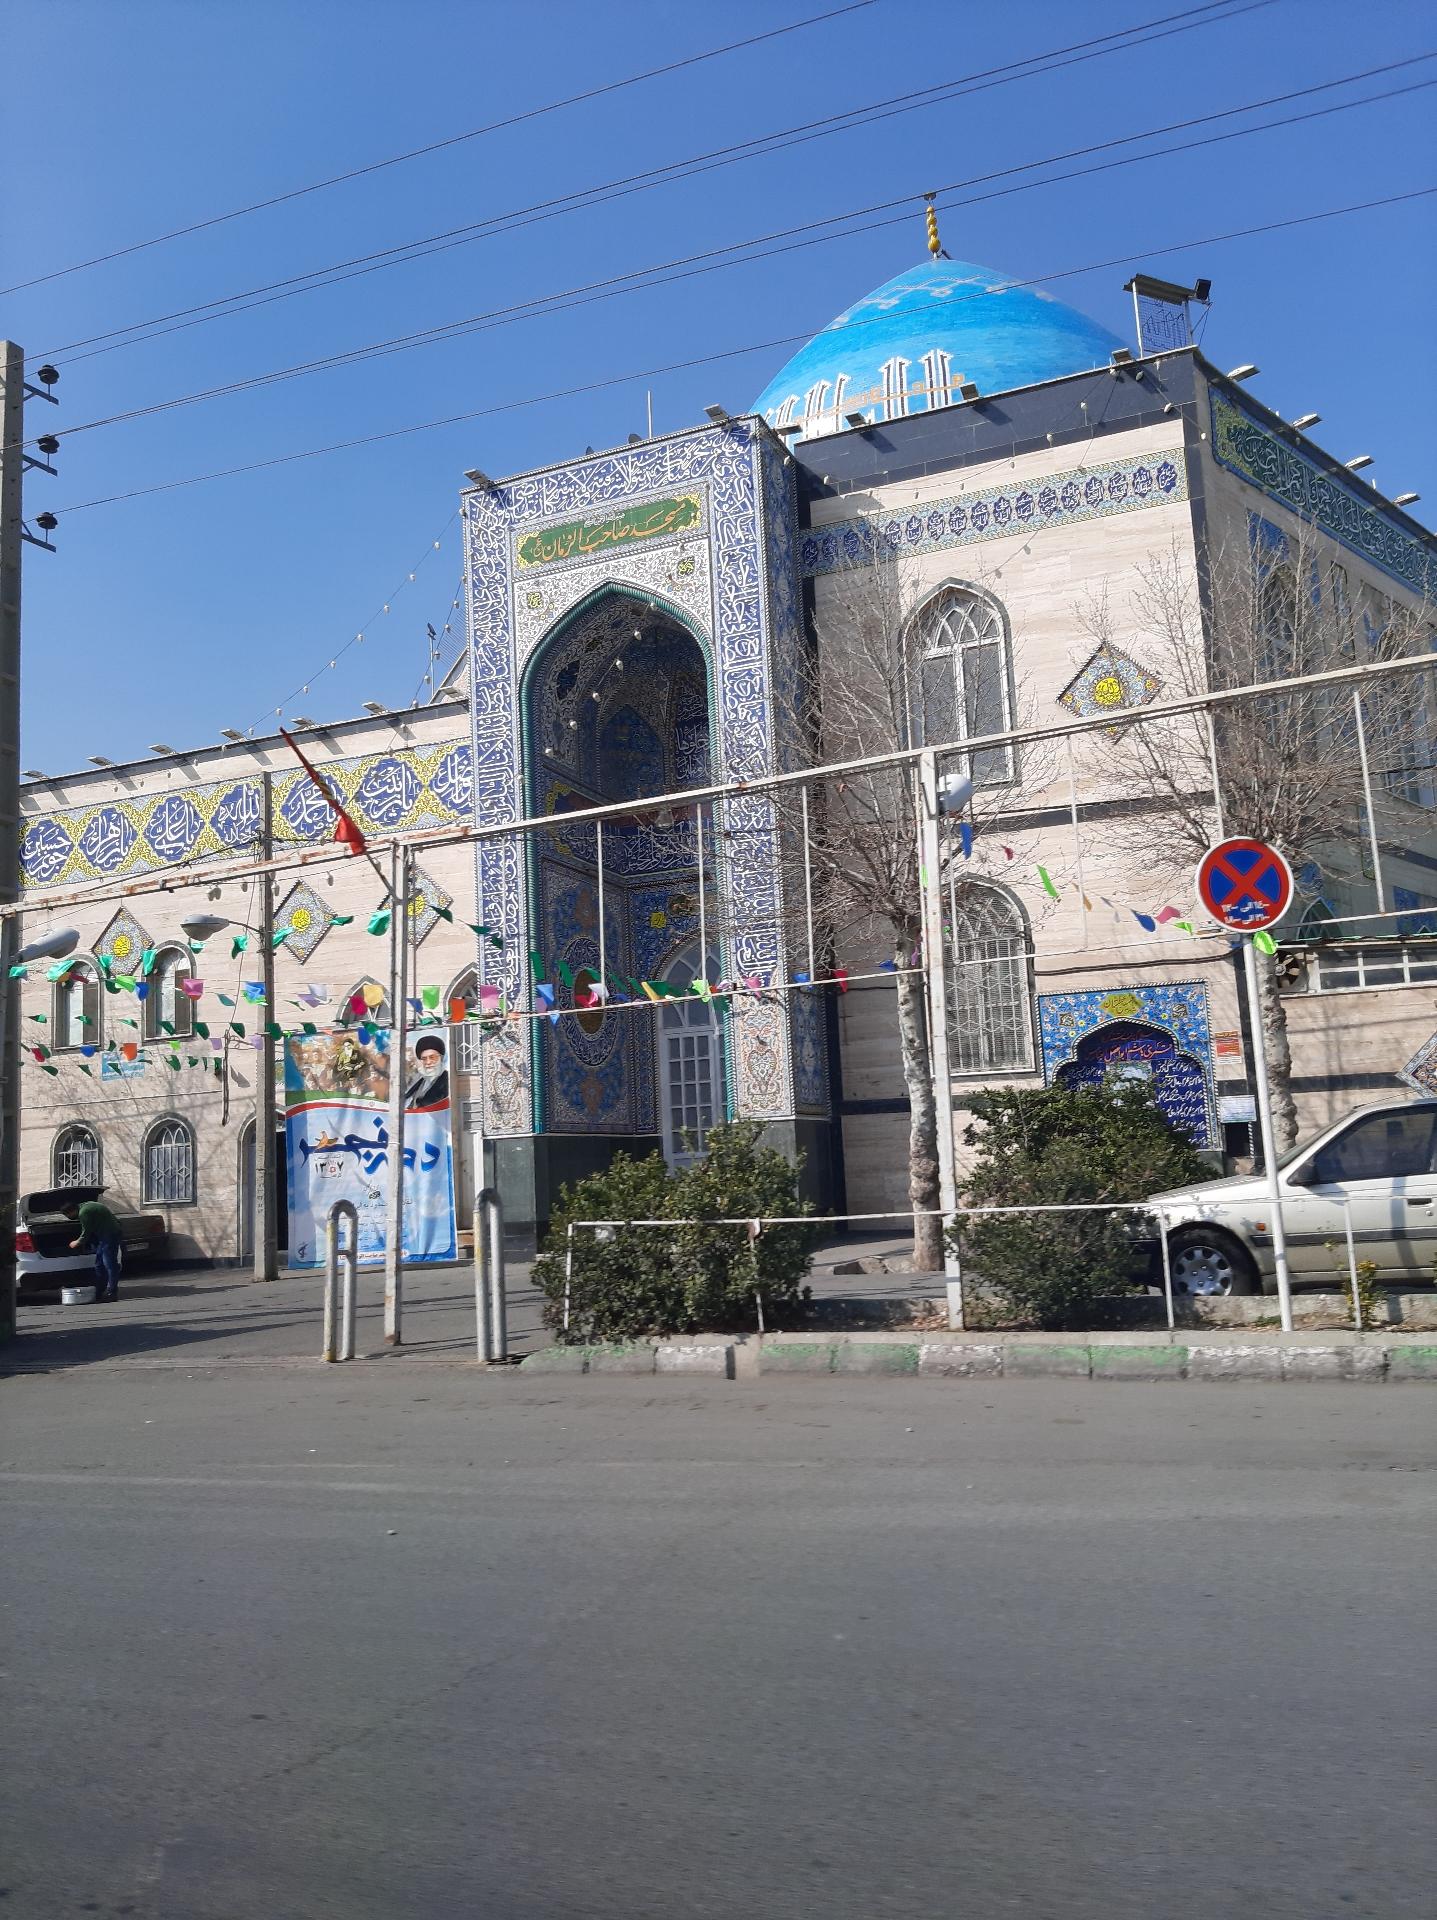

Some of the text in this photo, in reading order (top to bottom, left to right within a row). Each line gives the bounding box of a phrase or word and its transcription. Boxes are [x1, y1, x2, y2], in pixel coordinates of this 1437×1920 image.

[581, 520, 630, 553] صاحب
[630, 503, 686, 537] مسجد
[542, 528, 583, 560] الزمان
